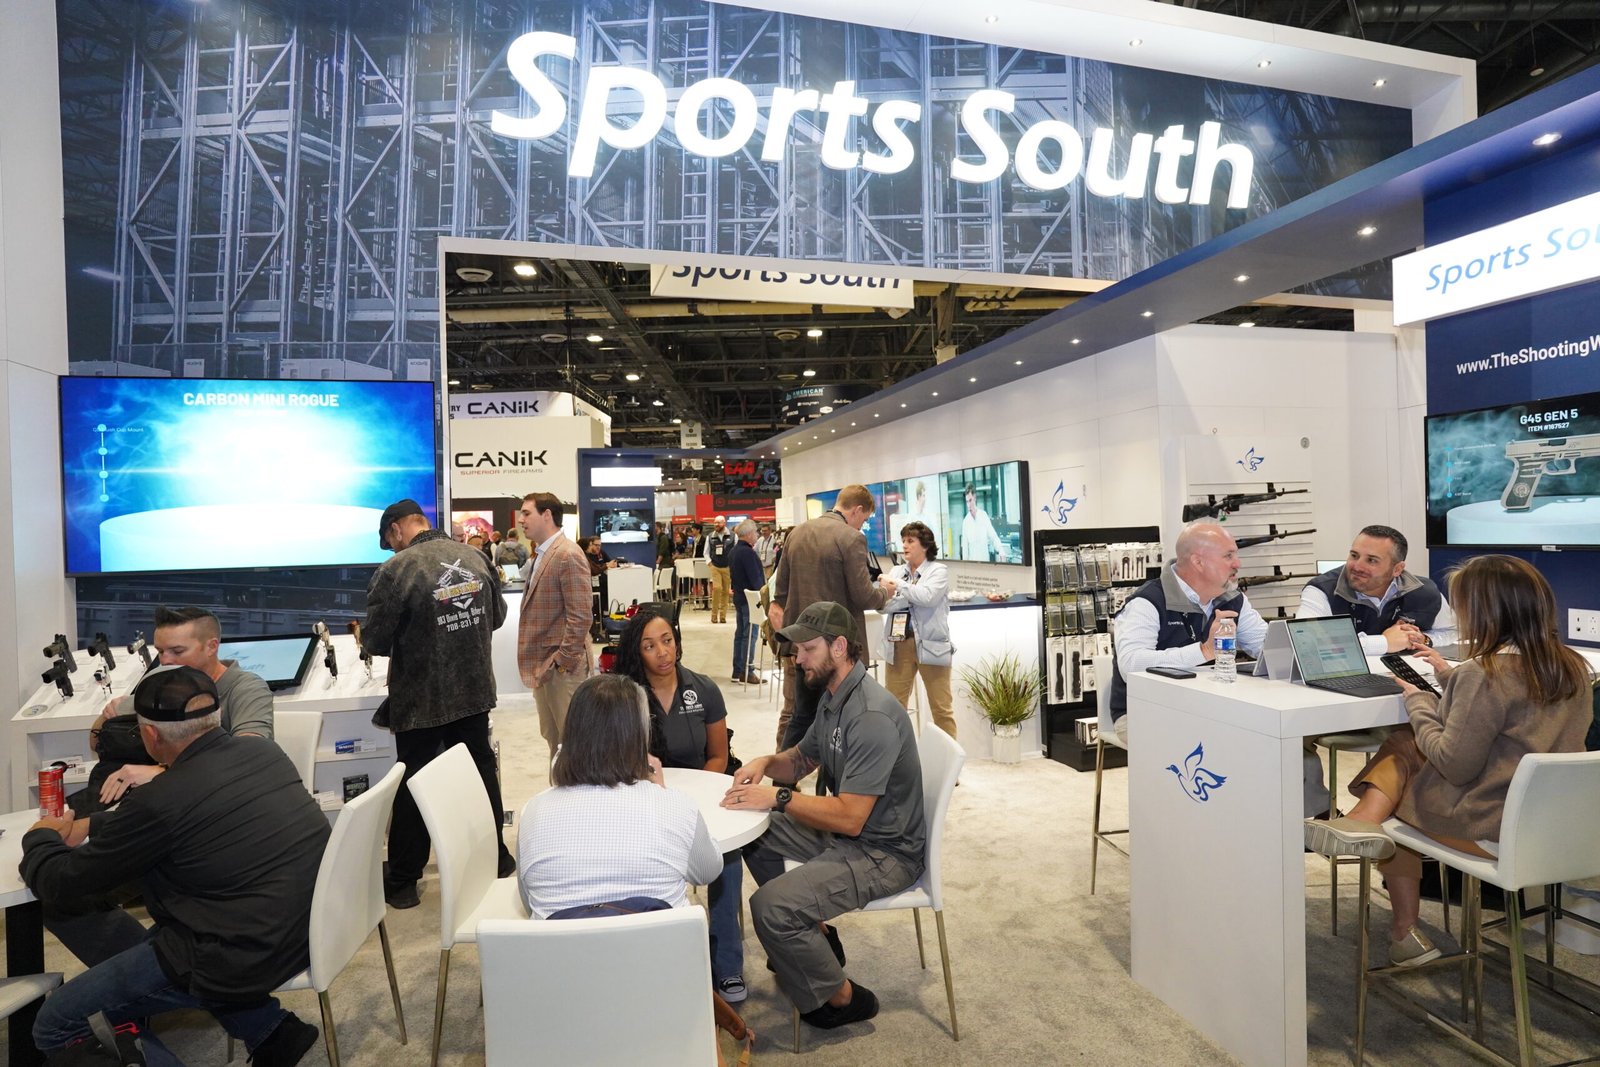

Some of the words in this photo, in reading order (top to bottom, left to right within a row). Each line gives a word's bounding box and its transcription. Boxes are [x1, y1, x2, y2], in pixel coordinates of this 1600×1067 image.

[491, 31, 923, 178] Sports
[951, 89, 1255, 210] South
[1426, 243, 1532, 294] Sports
[183, 392, 248, 406] CARBON
[252, 393, 286, 407] MINI
[288, 393, 340, 408] ROGUE
[1520, 413, 1542, 425] G45
[1543, 410, 1568, 421] GEN
[1570, 408, 1579, 419] 5
